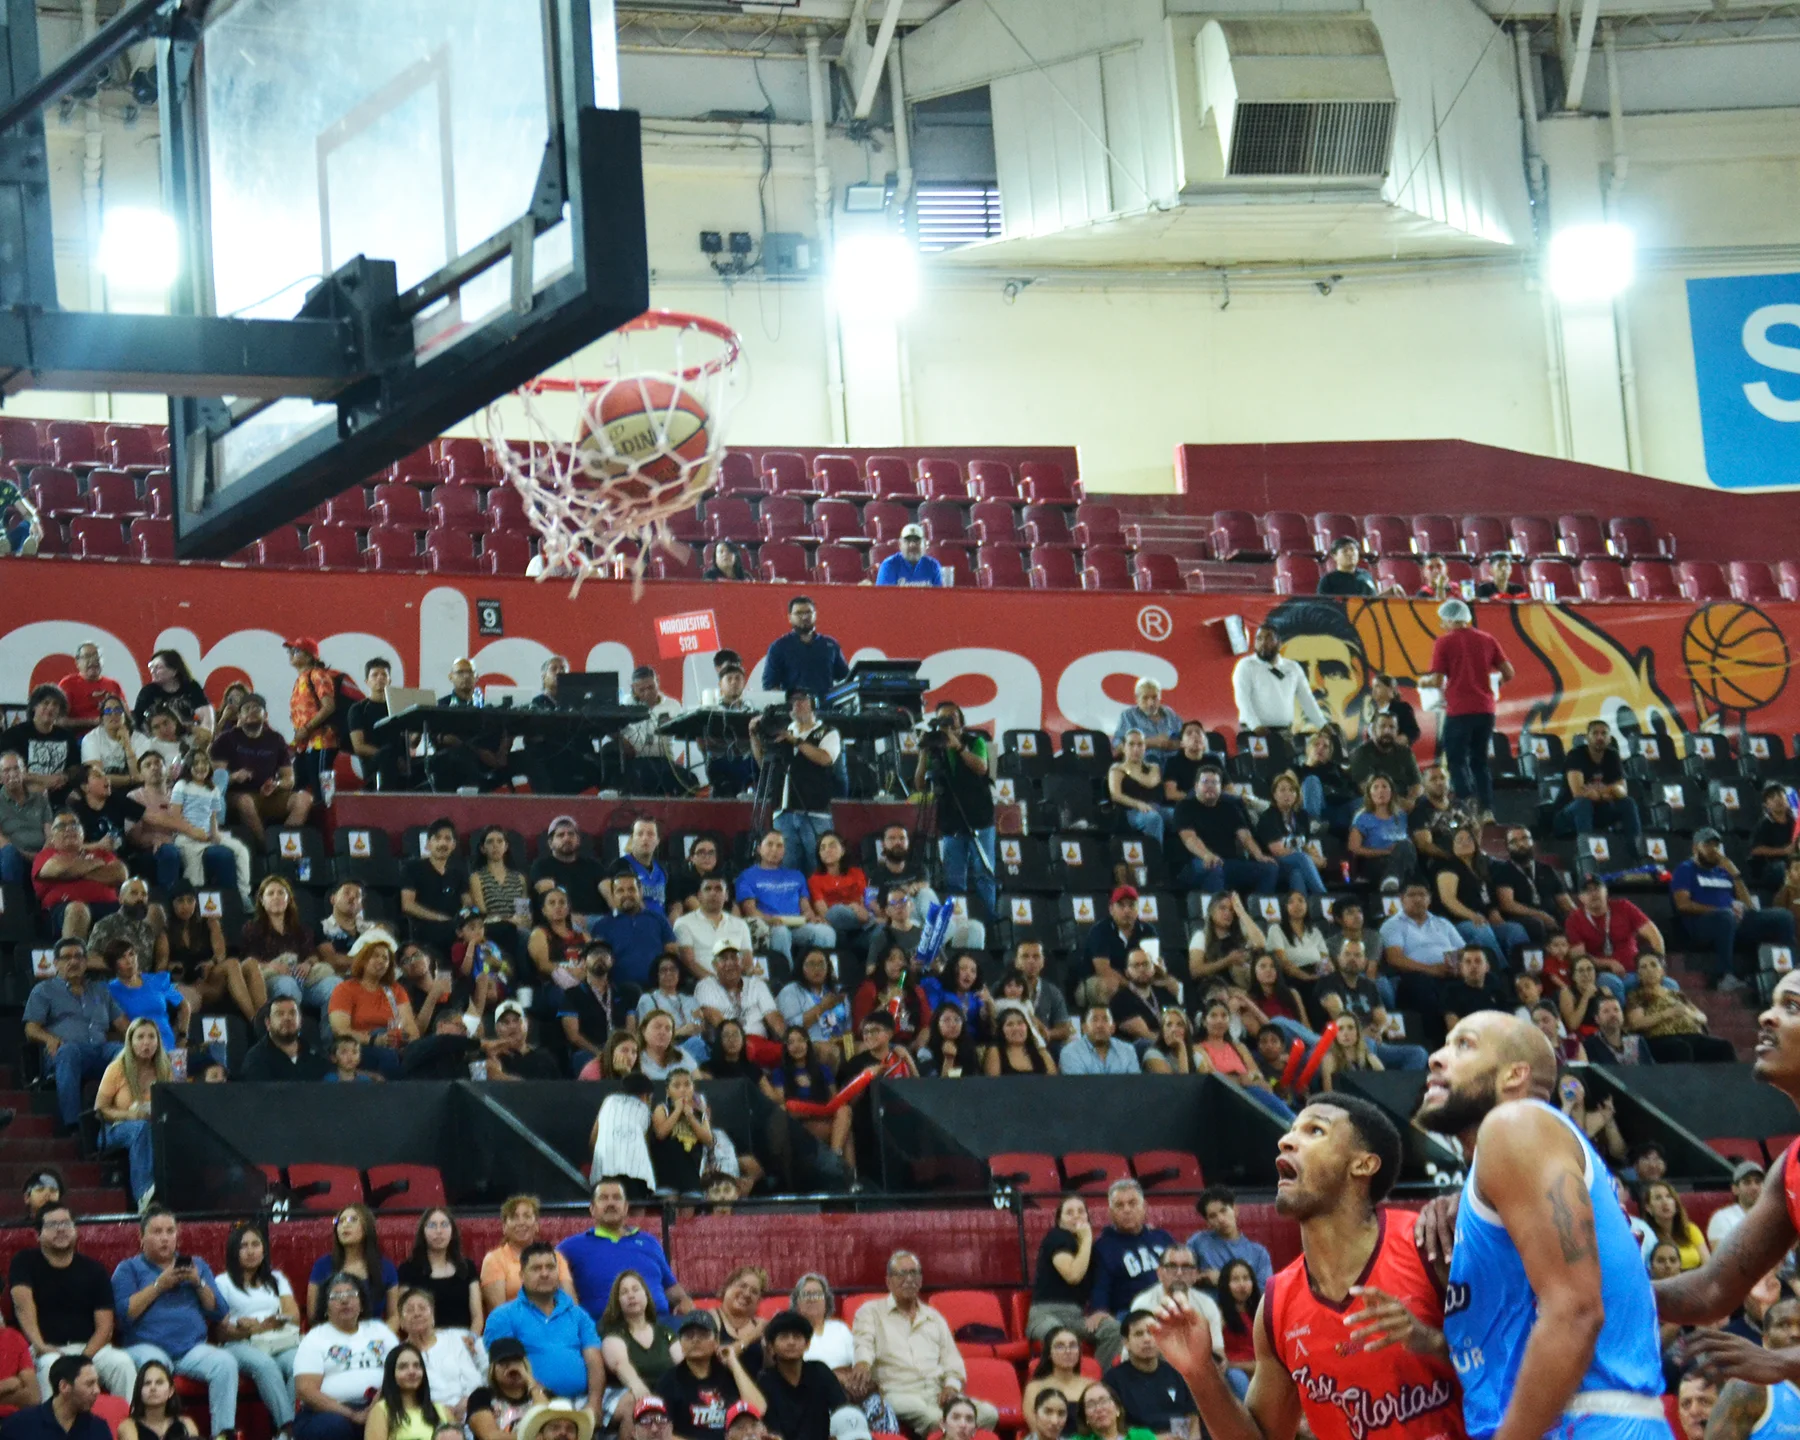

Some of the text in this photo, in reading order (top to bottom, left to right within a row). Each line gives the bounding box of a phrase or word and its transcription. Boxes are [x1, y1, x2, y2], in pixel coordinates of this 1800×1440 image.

[483, 608, 497, 628] 9
[659, 614, 711, 635] MARQUESITAS
[679, 634, 699, 653] $120
[1331, 1379, 1451, 1440] Glorias
